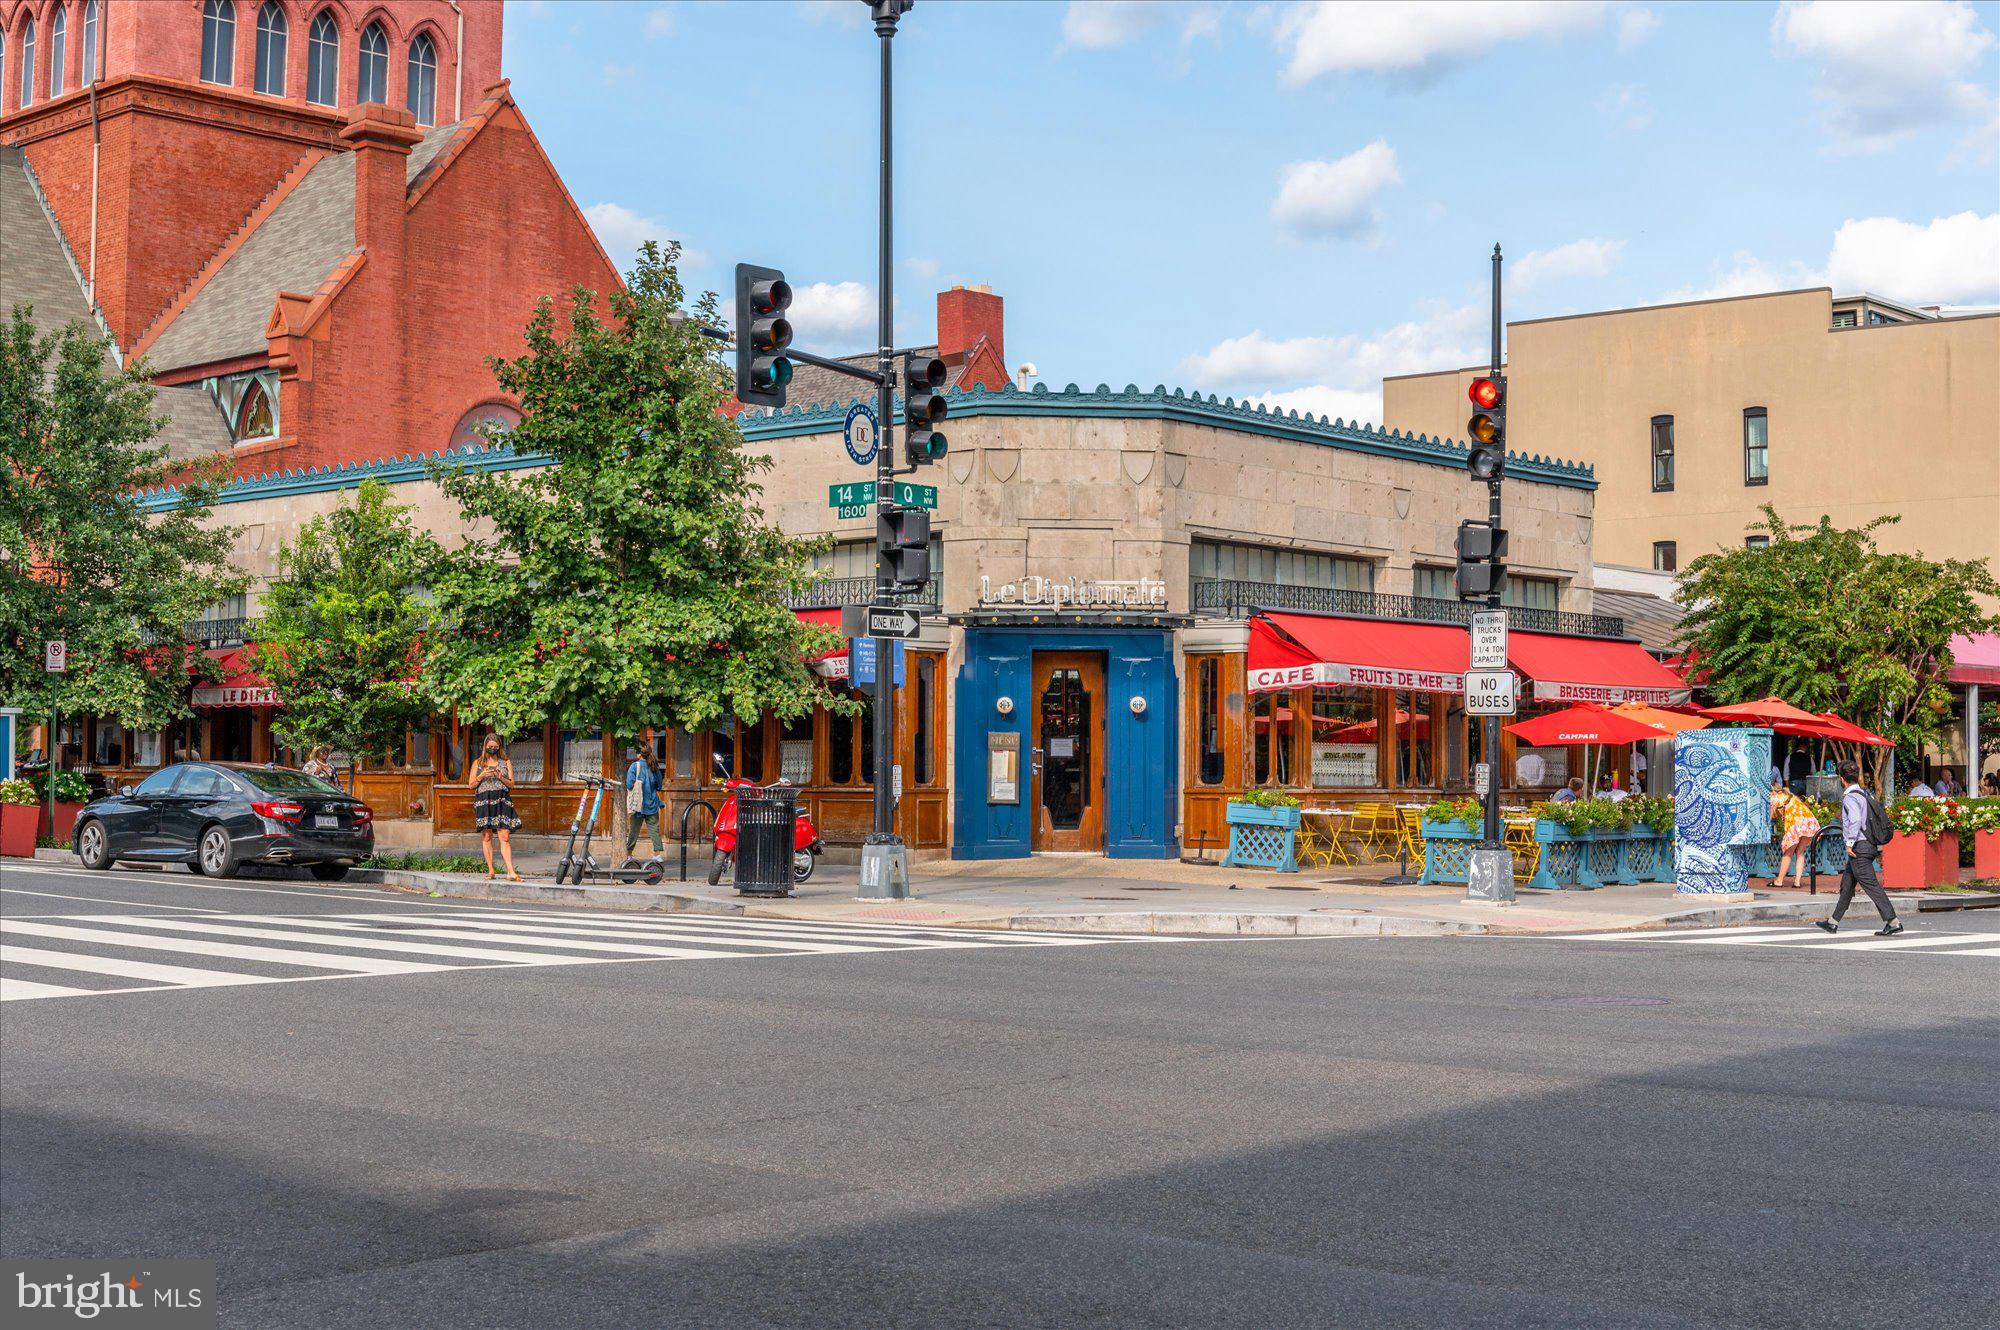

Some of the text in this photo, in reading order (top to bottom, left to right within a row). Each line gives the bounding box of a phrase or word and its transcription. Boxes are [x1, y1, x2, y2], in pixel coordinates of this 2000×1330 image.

[849, 406, 874, 421] GREATER
[856, 427, 869, 442] DC
[859, 444, 878, 462] STREET
[838, 486, 853, 503] 14
[863, 493, 872, 501] NW
[903, 485, 932, 503] Q ST
[923, 497, 933, 505] NW
[839, 504, 866, 518] 1600
[980, 575, 1166, 613] Le Diplomate
[873, 616, 904, 629] ONE WAY
[1477, 626, 1502, 634] TRUCKS
[1481, 636, 1497, 644] OVER
[1257, 667, 1315, 686] CAFE
[1349, 668, 1393, 685] FRUITS
[1398, 672, 1414, 686] DE
[1418, 674, 1443, 689] MER
[1480, 678, 1497, 691] NO
[222, 690, 236, 702] LE
[1559, 685, 1612, 700] BRASSERIE
[1622, 690, 1670, 703] APERITIFS
[1470, 695, 1509, 708] BUSES
